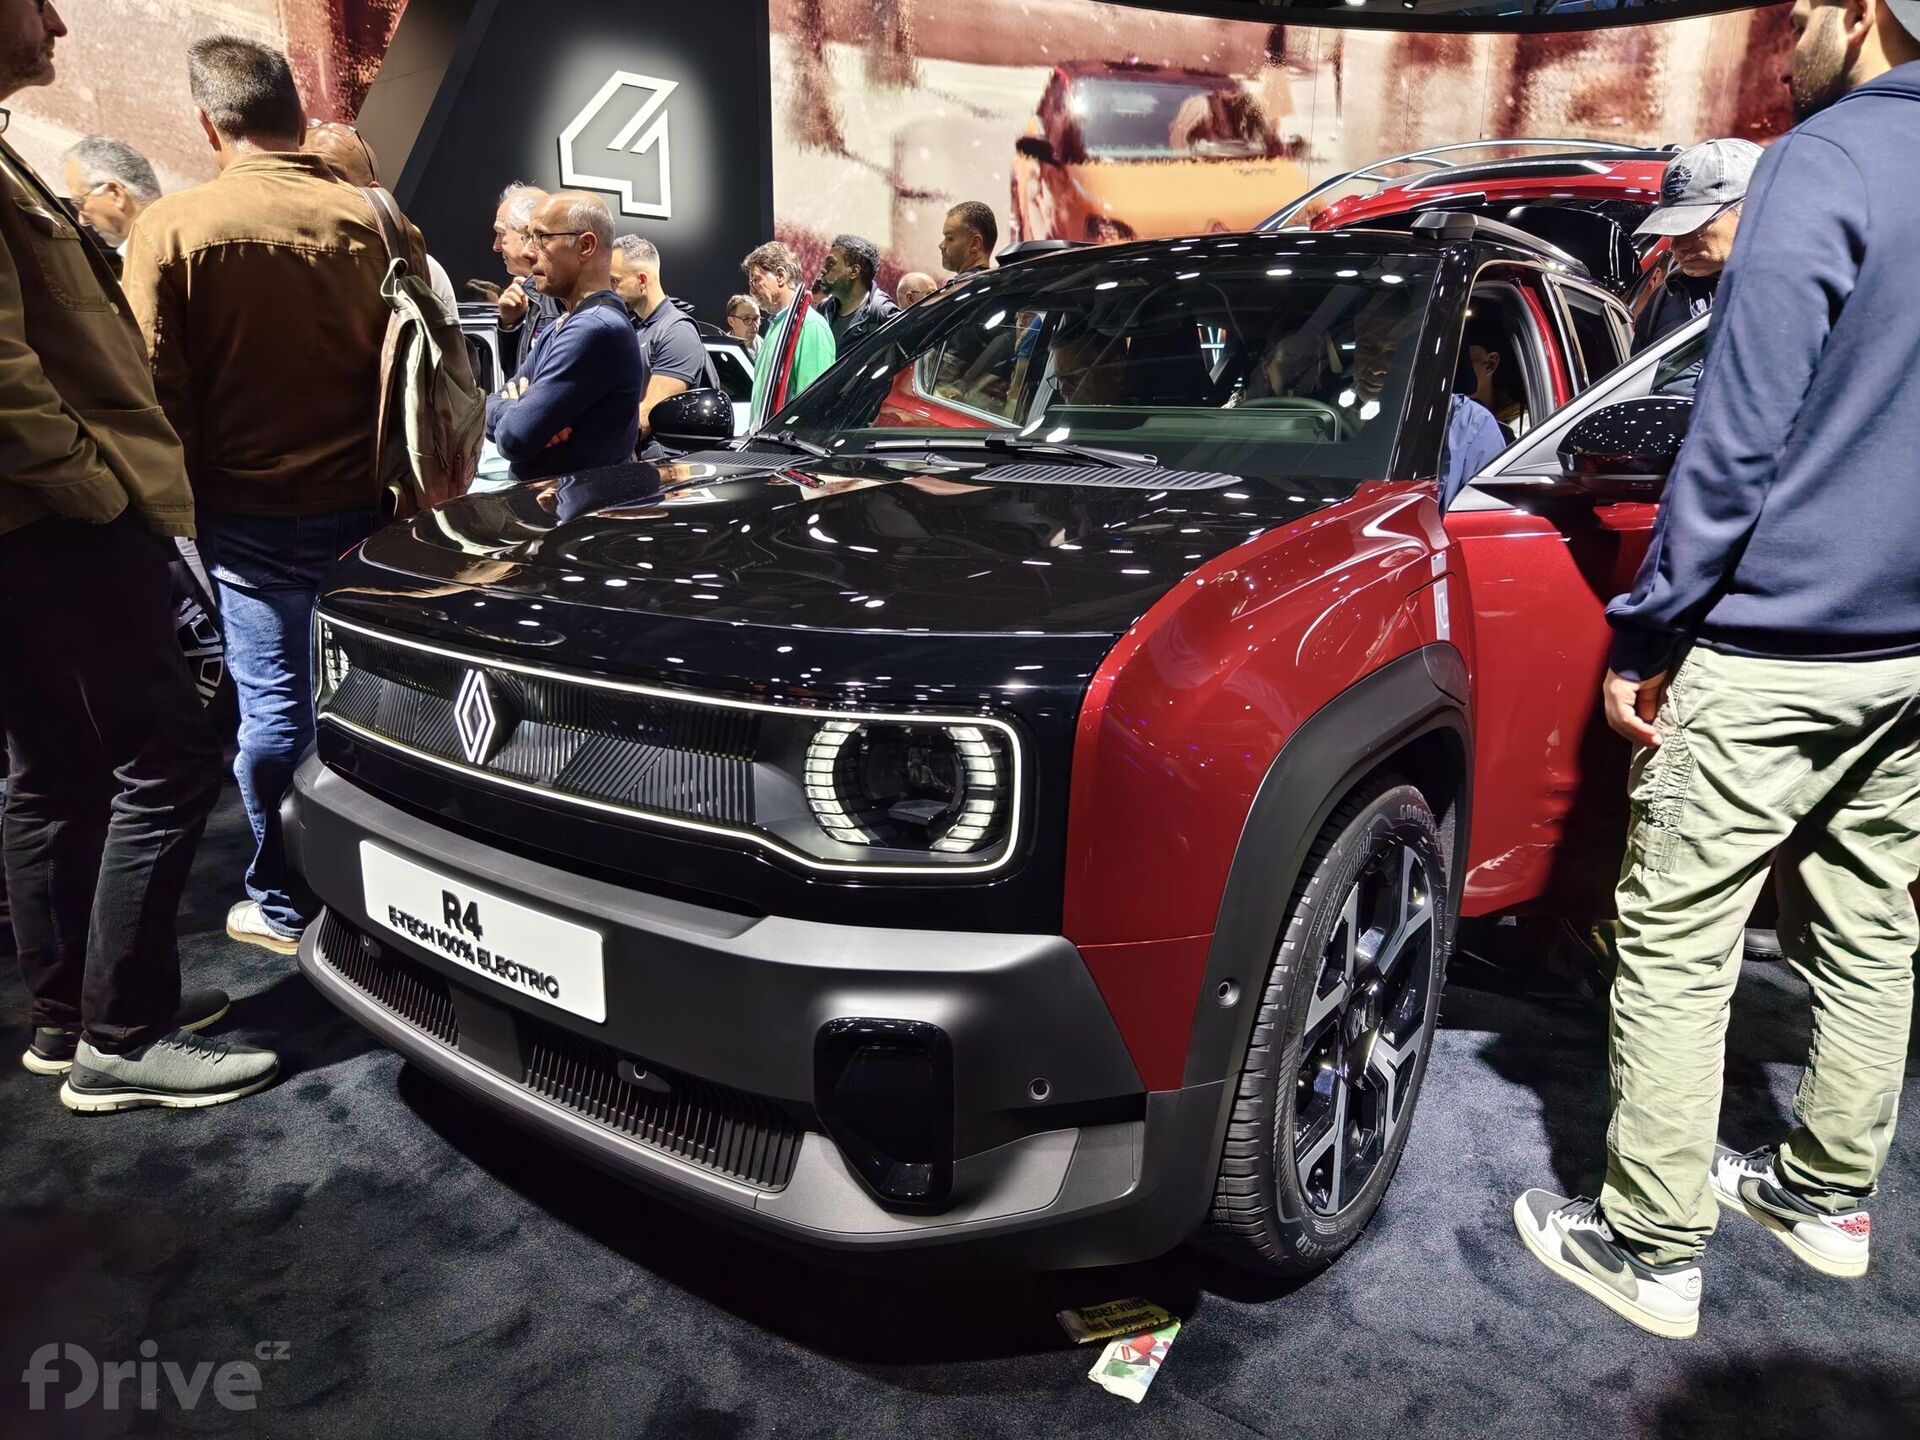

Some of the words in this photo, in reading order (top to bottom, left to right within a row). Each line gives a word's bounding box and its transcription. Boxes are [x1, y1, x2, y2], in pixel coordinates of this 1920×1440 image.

[388, 904, 437, 947] E-TECH
[435, 928, 476, 965] 100%
[477, 947, 560, 999] ELECTRIC
[441, 889, 483, 942] R4
